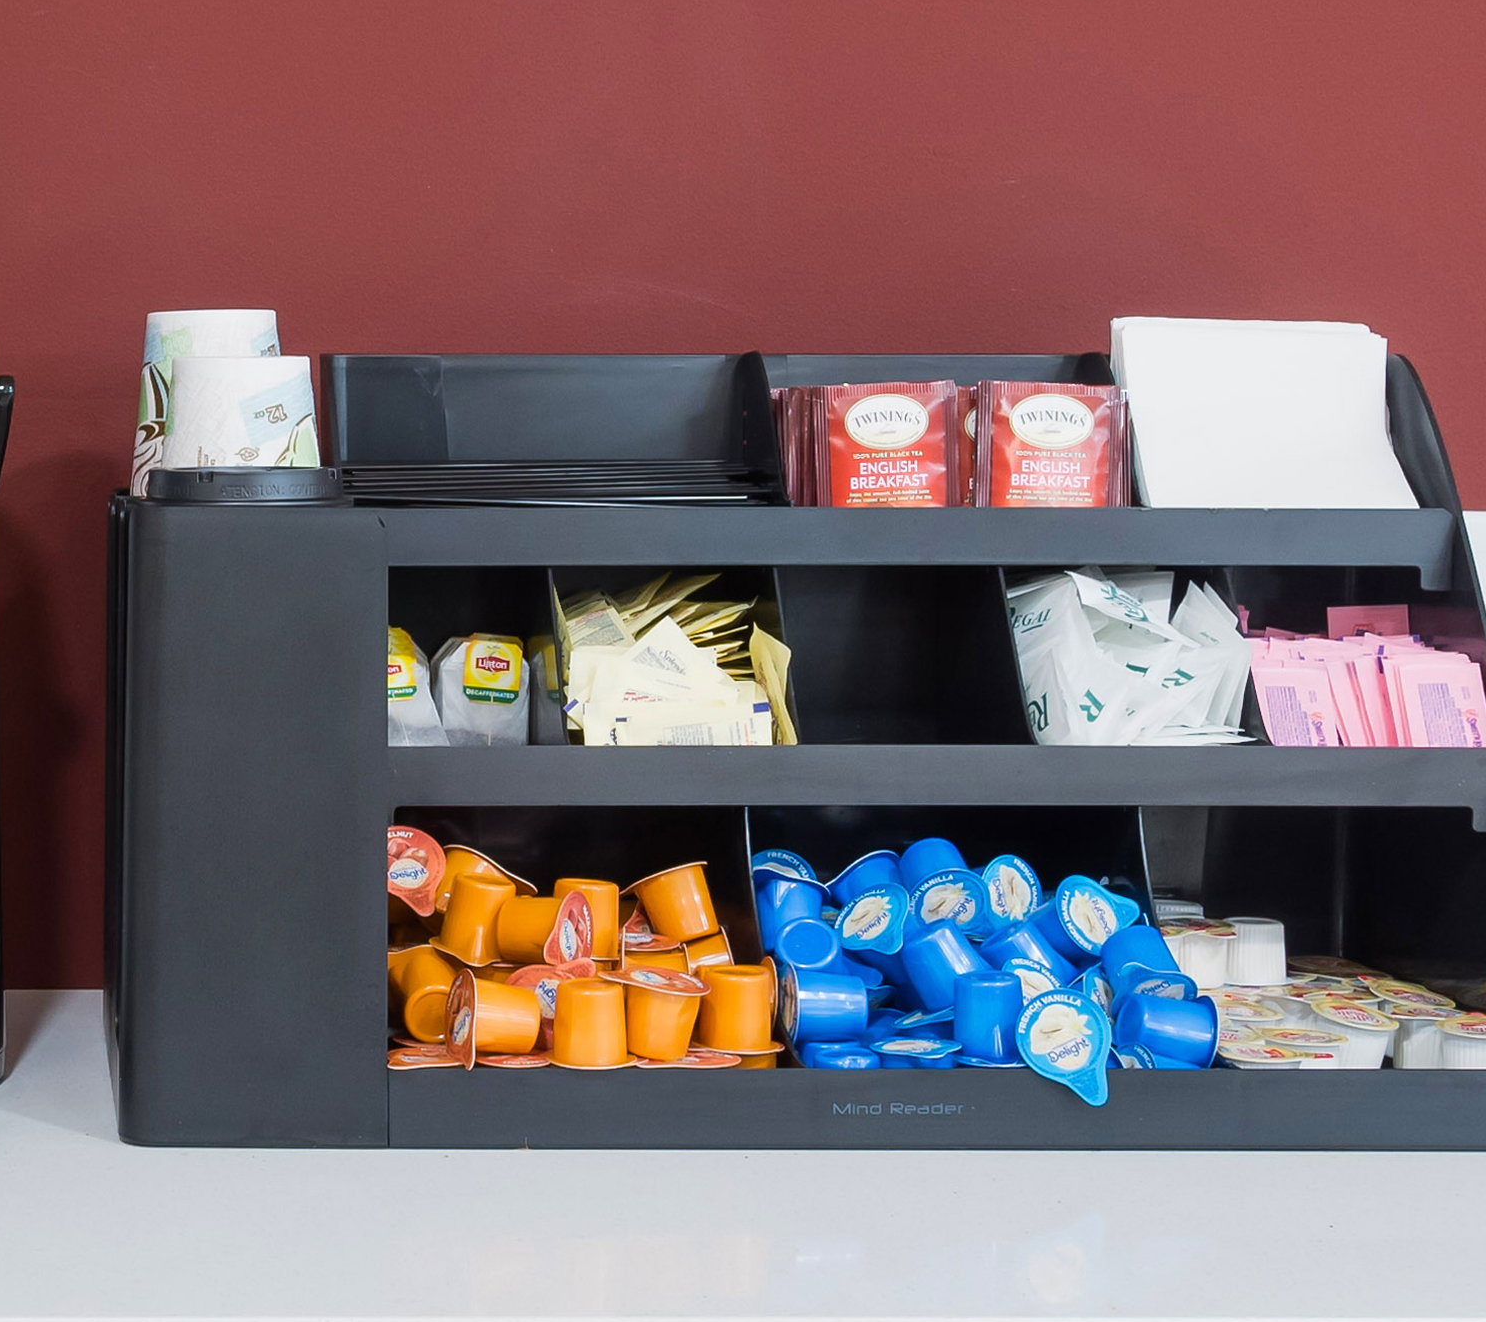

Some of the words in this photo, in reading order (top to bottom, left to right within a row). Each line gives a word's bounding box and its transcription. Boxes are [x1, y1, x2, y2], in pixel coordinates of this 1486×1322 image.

[254, 410, 265, 419] oz
[265, 404, 287, 424] 12
[853, 410, 920, 428] TWININGS
[1019, 410, 1086, 428] TWININGS
[859, 460, 918, 475] ENGLISH
[1021, 460, 1080, 474] ENGLISH
[850, 473, 928, 490] BREAKFAST
[1011, 474, 1091, 489] BREAKFAST
[477, 658, 508, 672] Lipton
[388, 830, 414, 839] ELNUT
[920, 874, 954, 893] VANILLA
[993, 878, 1008, 917] Delight
[855, 912, 889, 939] Delight
[1010, 957, 1040, 971] FRENCH
[1018, 999, 1042, 1035] FRENCH
[1041, 993, 1081, 1007] VANILLA
[1048, 1038, 1090, 1063] Delight
[832, 1102, 882, 1115] Mind
[890, 1102, 964, 1115] Reader
